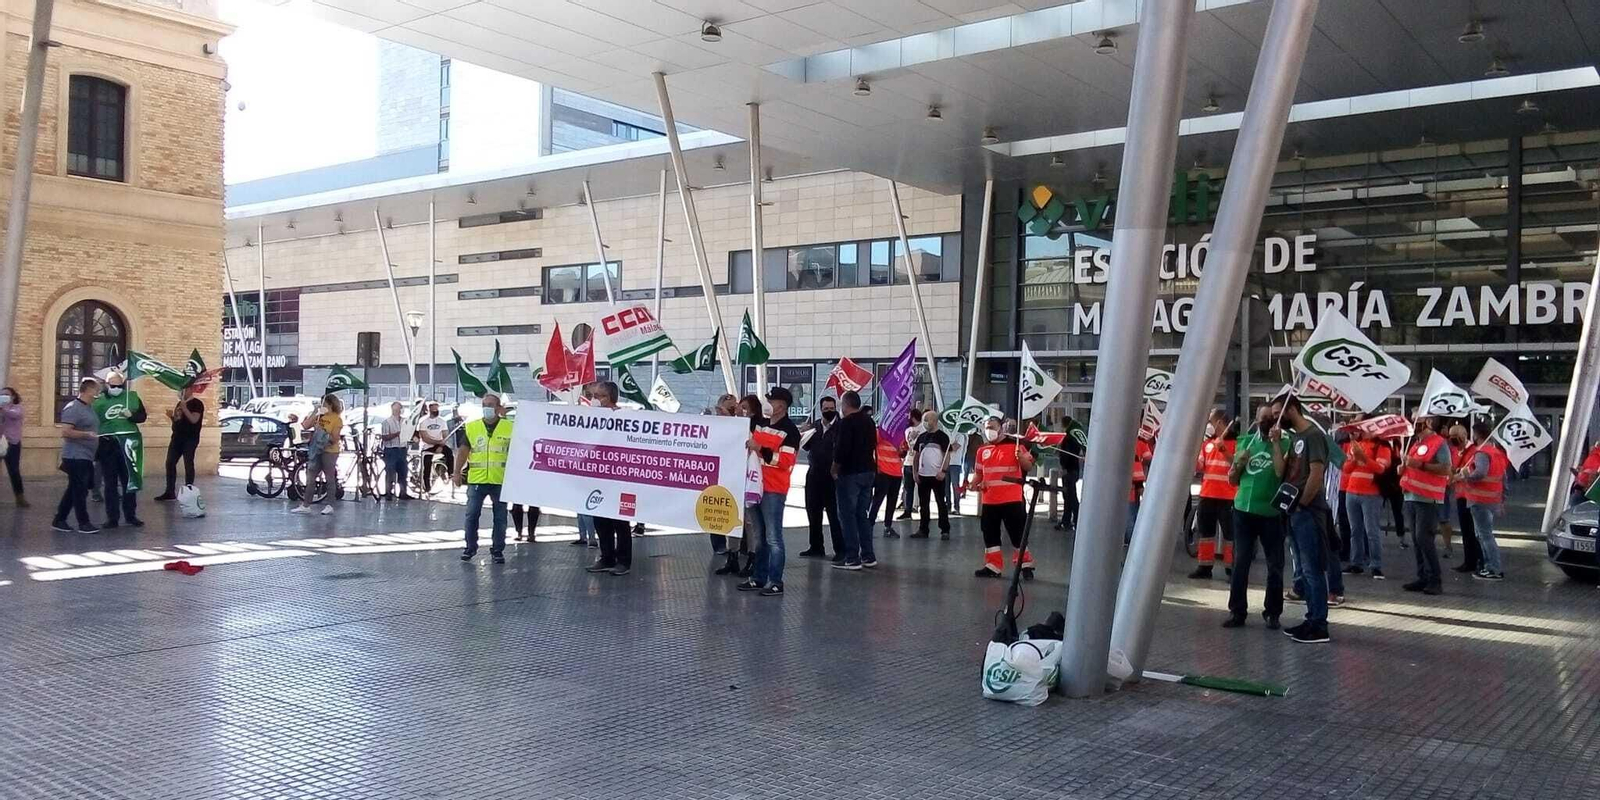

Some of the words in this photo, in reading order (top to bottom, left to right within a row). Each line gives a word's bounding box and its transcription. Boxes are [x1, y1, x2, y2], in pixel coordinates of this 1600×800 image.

[1074, 232, 1211, 285] ESCIÓ
[1264, 234, 1317, 274] DE
[224, 342, 233, 354] DE
[235, 340, 263, 354] MLAGA
[223, 354, 244, 368] MARÍA
[248, 355, 286, 368] ZAMRANO
[546, 412, 640, 433] TRABAJADORES
[642, 420, 660, 435] DE
[662, 422, 709, 439] BTREN
[626, 434, 672, 447] Mantenimiento
[673, 438, 708, 450] Ferroviario
[544, 444, 556, 454] EN
[556, 446, 589, 458] DEFENSA
[590, 449, 601, 460] DE
[602, 451, 620, 462] LOS
[620, 452, 660, 466] PUESTOS
[660, 457, 672, 468] DE
[673, 458, 715, 472] TRABAJO
[547, 457, 557, 467] EN
[558, 459, 567, 469] EL
[568, 460, 598, 473] TALLER
[598, 463, 611, 474] DE
[611, 465, 628, 476] LOS
[628, 467, 663, 480] PRADOS
[669, 470, 709, 485] MÁLAGA
[702, 495, 733, 508] RENFE,
